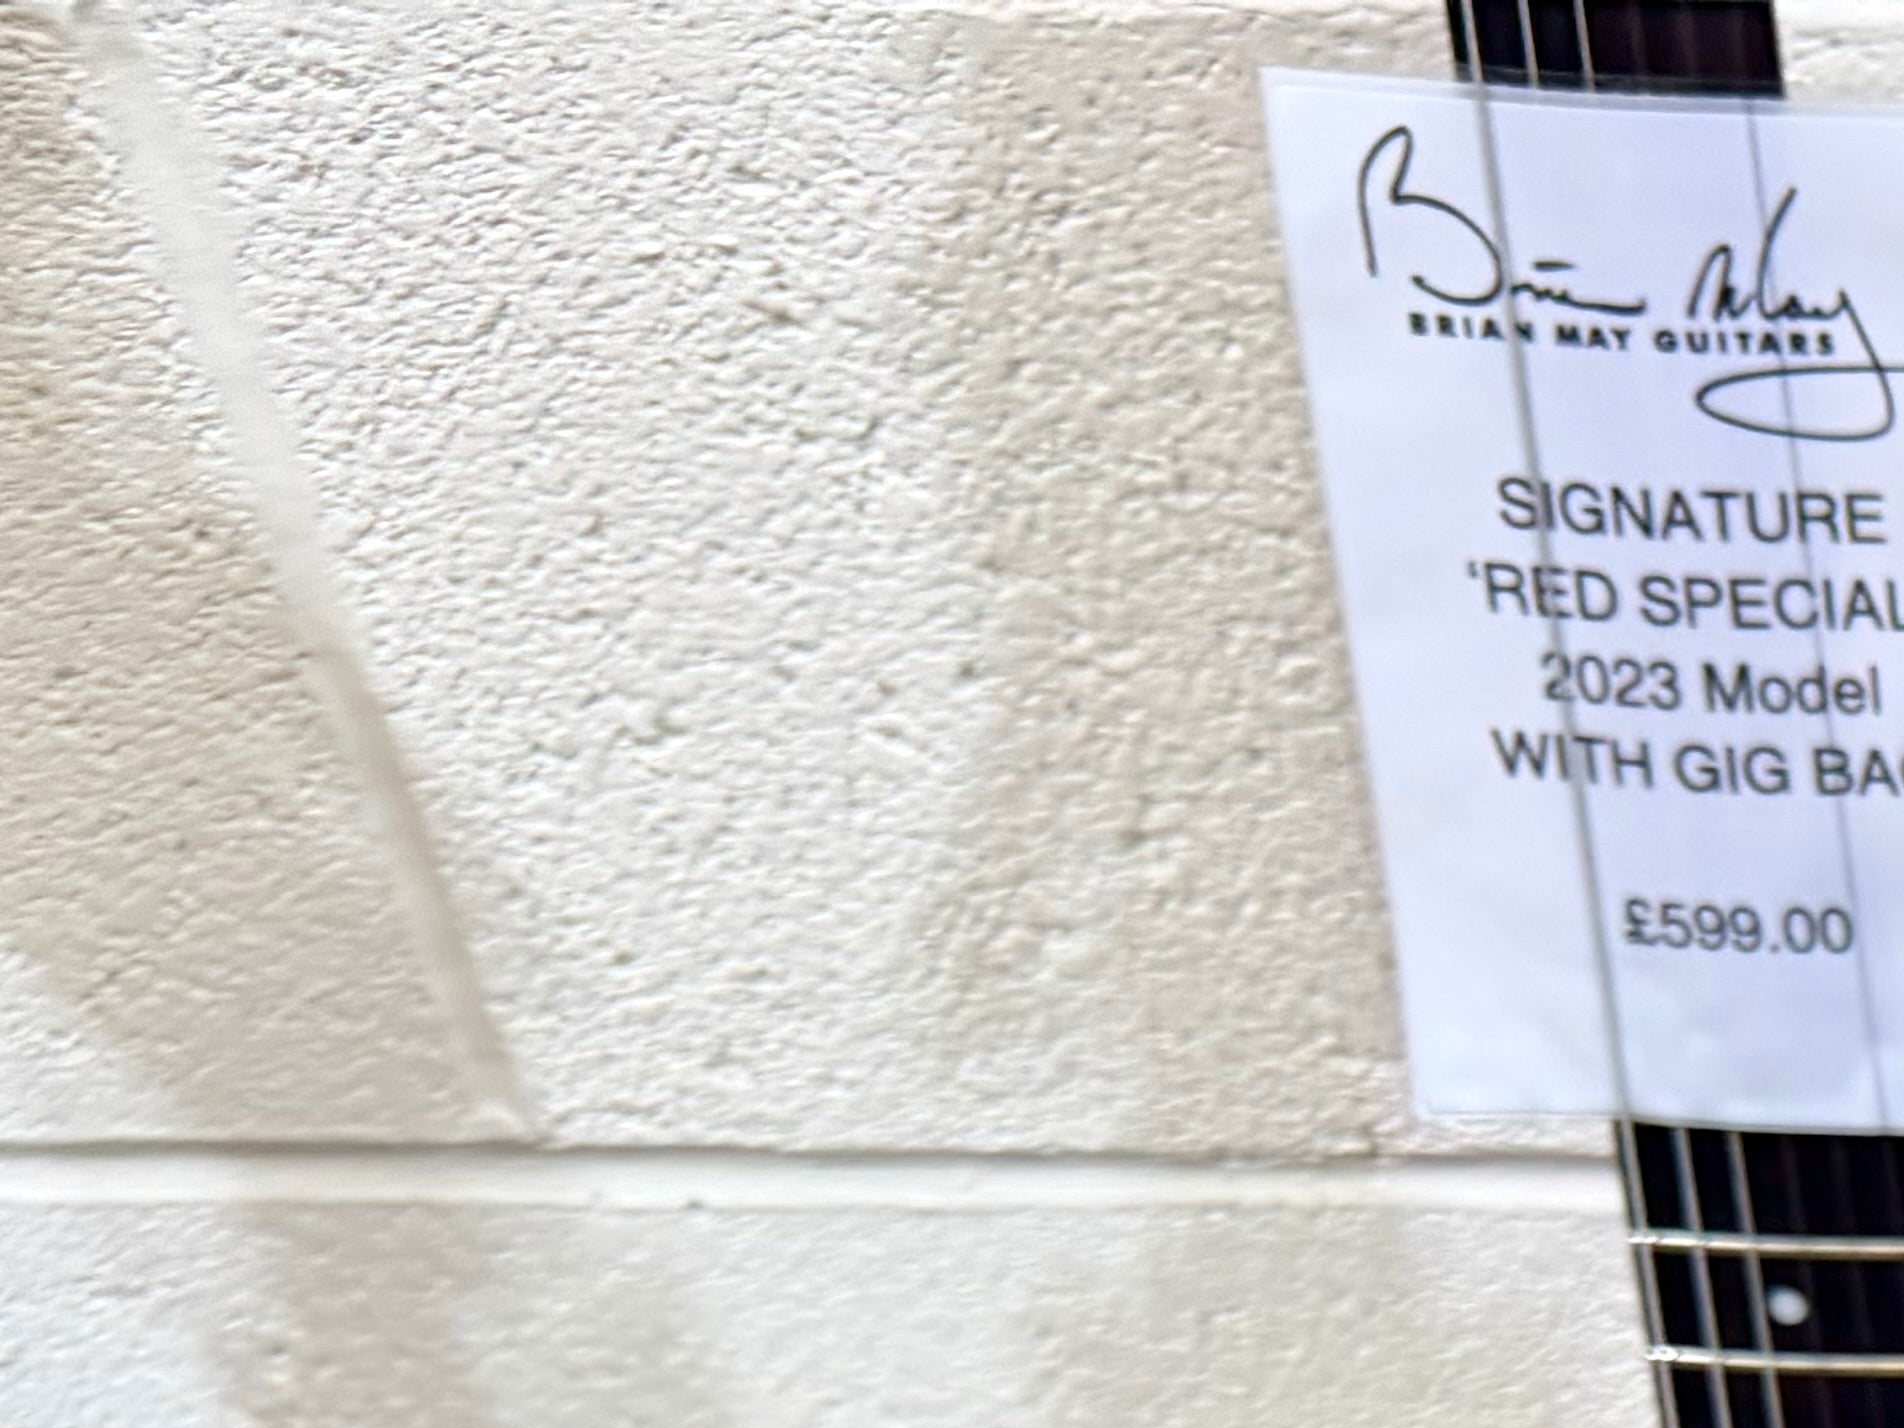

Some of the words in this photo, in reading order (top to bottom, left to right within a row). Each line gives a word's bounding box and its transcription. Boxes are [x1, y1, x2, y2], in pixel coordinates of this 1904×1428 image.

[1408, 312, 1535, 344] BRIAN
[1554, 325, 1632, 352] MAY
[1653, 329, 1837, 356] GUITARS
[1497, 475, 1889, 545] SIGNATURE
[1540, 650, 1681, 711] 2023
[1701, 661, 1882, 717] Model
[1490, 728, 1654, 788] WITH
[1672, 742, 1792, 795] GIG
[1623, 896, 1855, 956] £599.00
